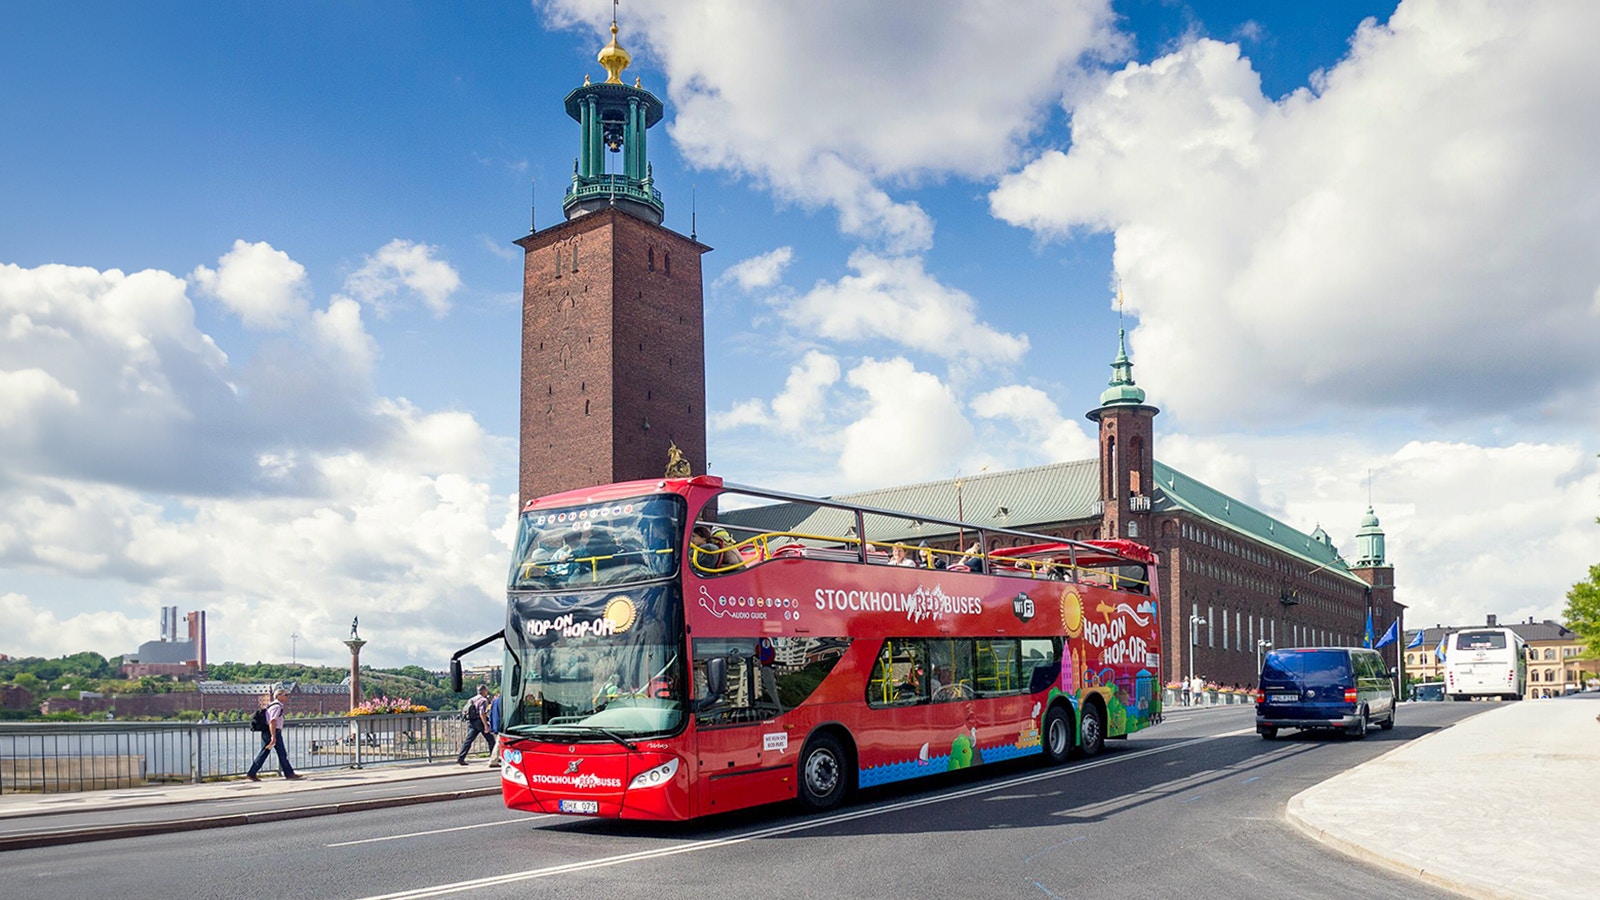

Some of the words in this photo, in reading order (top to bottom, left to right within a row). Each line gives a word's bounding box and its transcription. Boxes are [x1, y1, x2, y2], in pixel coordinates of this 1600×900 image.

[815, 588, 911, 612] STOCKHOLM
[944, 595, 982, 614] BUSES
[527, 613, 574, 636] HOP-ON
[563, 618, 616, 637] HOP-OFF
[1083, 615, 1126, 648] HOP-ON
[1104, 635, 1147, 665] HOP-OFF
[532, 775, 578, 785] STOCKHOLM
[596, 778, 621, 787] BUSES
